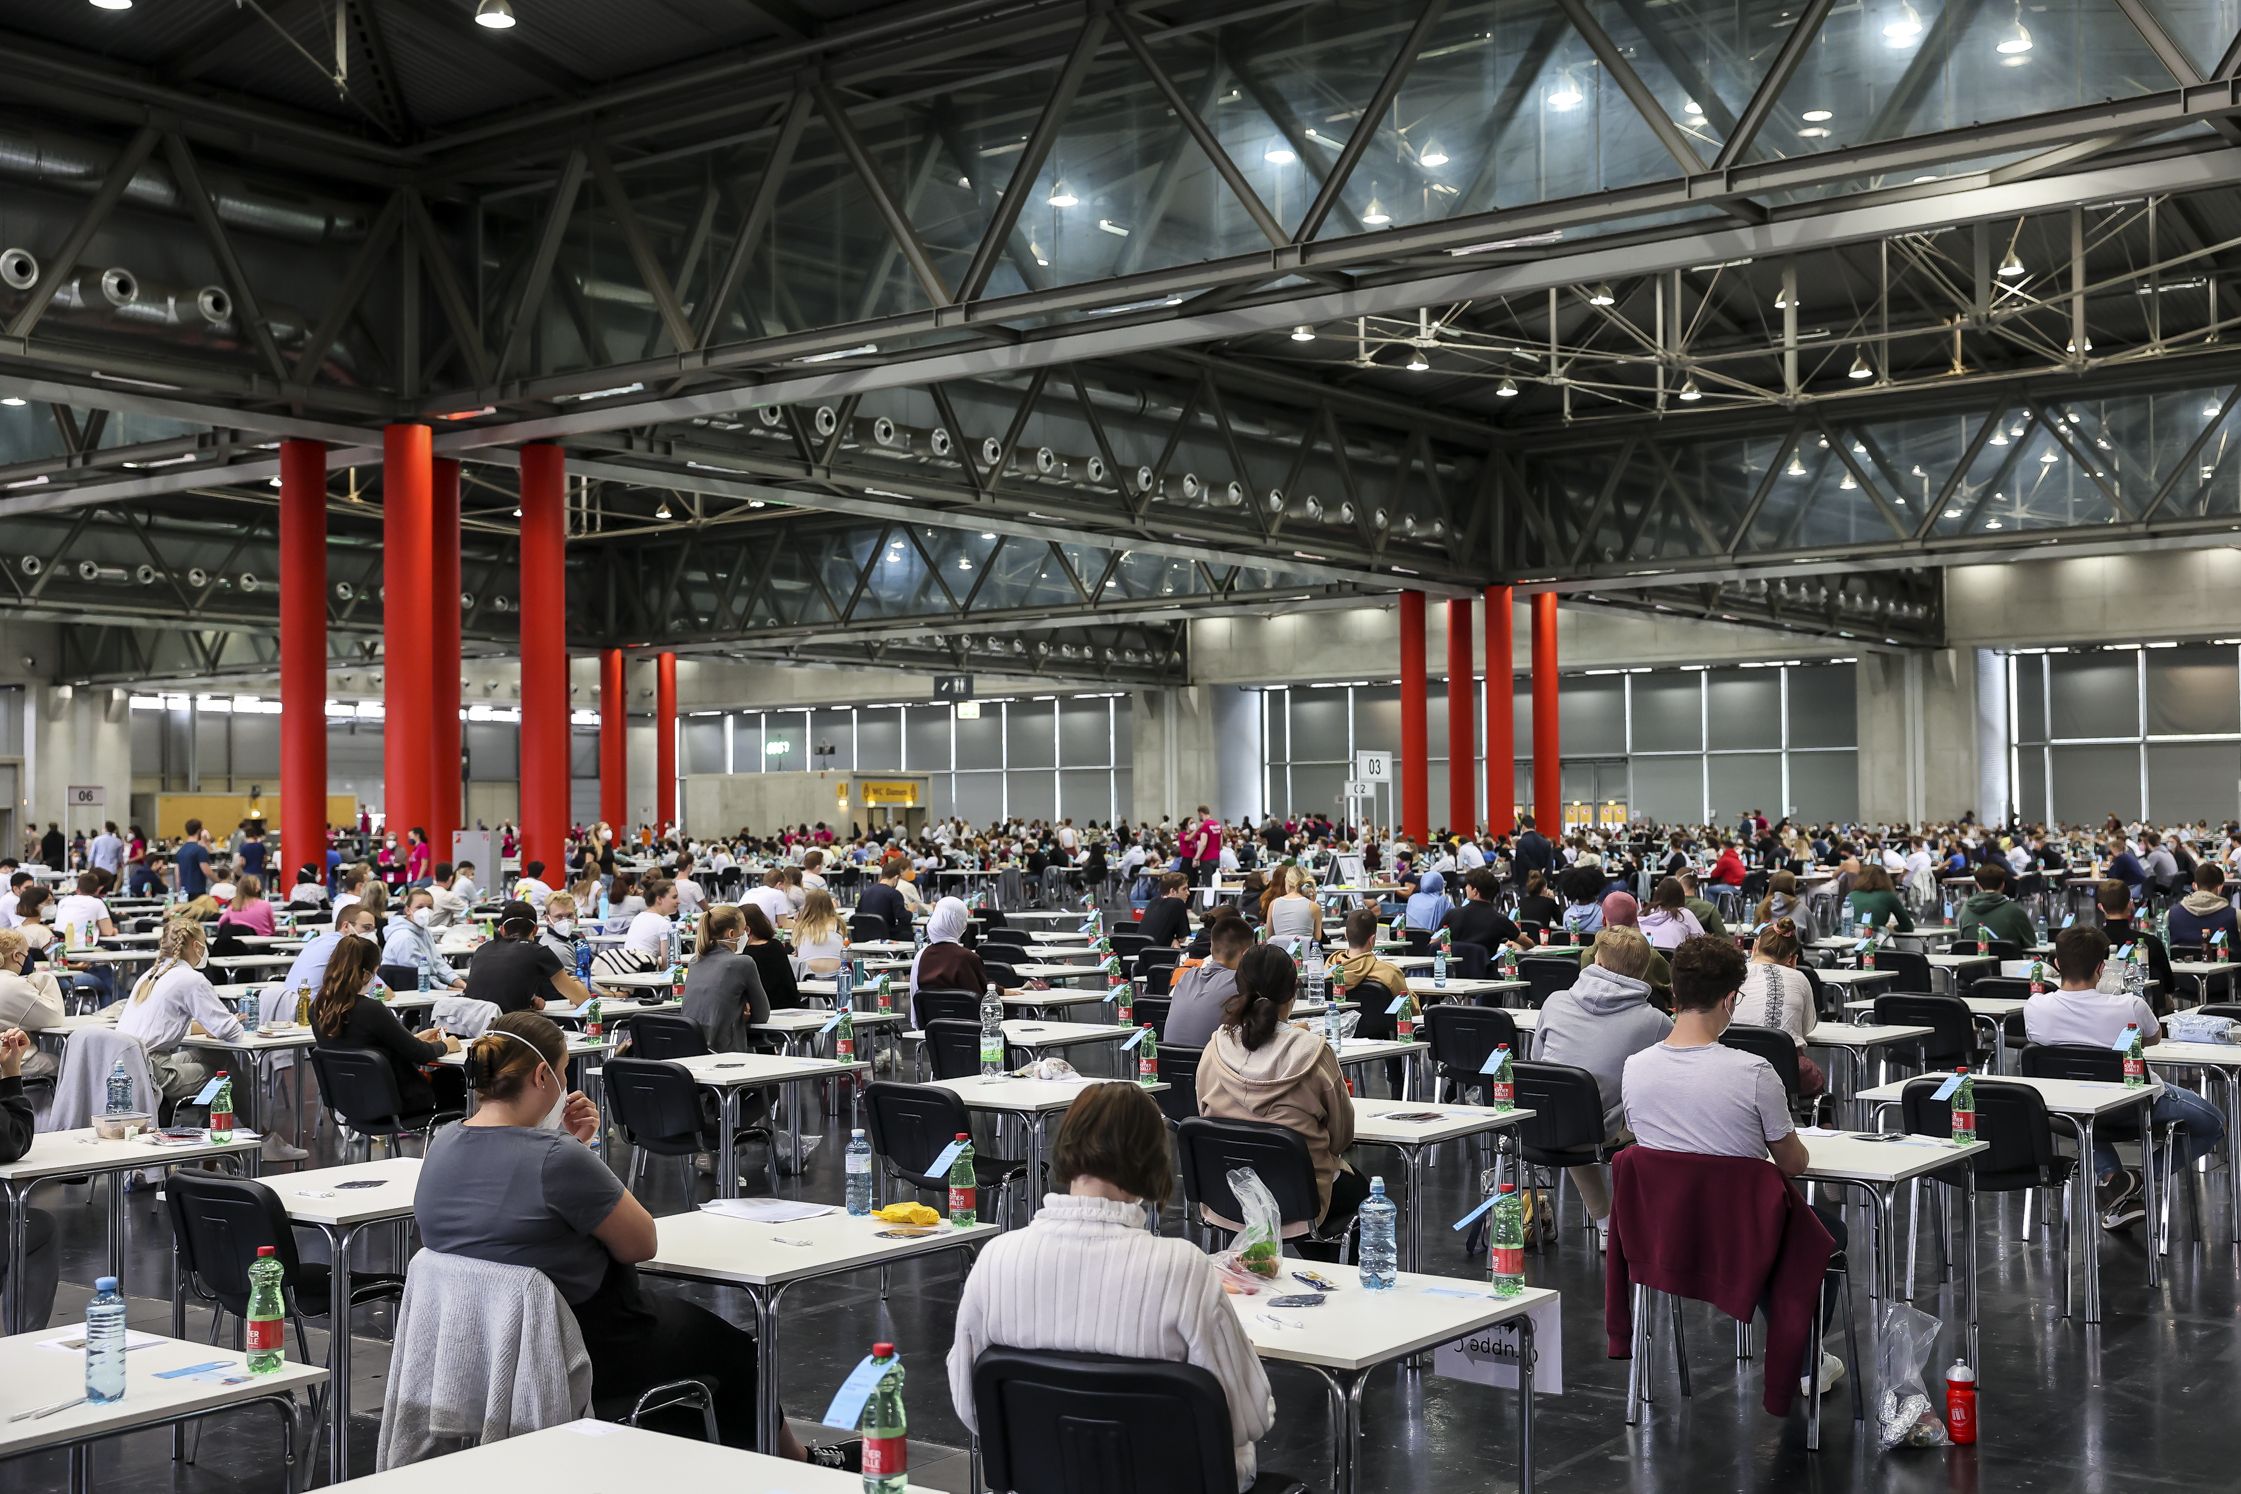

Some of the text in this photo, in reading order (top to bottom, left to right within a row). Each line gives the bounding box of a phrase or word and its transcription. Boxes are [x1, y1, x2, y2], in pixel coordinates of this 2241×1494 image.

[1368, 758, 1381, 775] 03
[78, 790, 94, 802] 06
[1470, 1337, 1539, 1363] uppe
